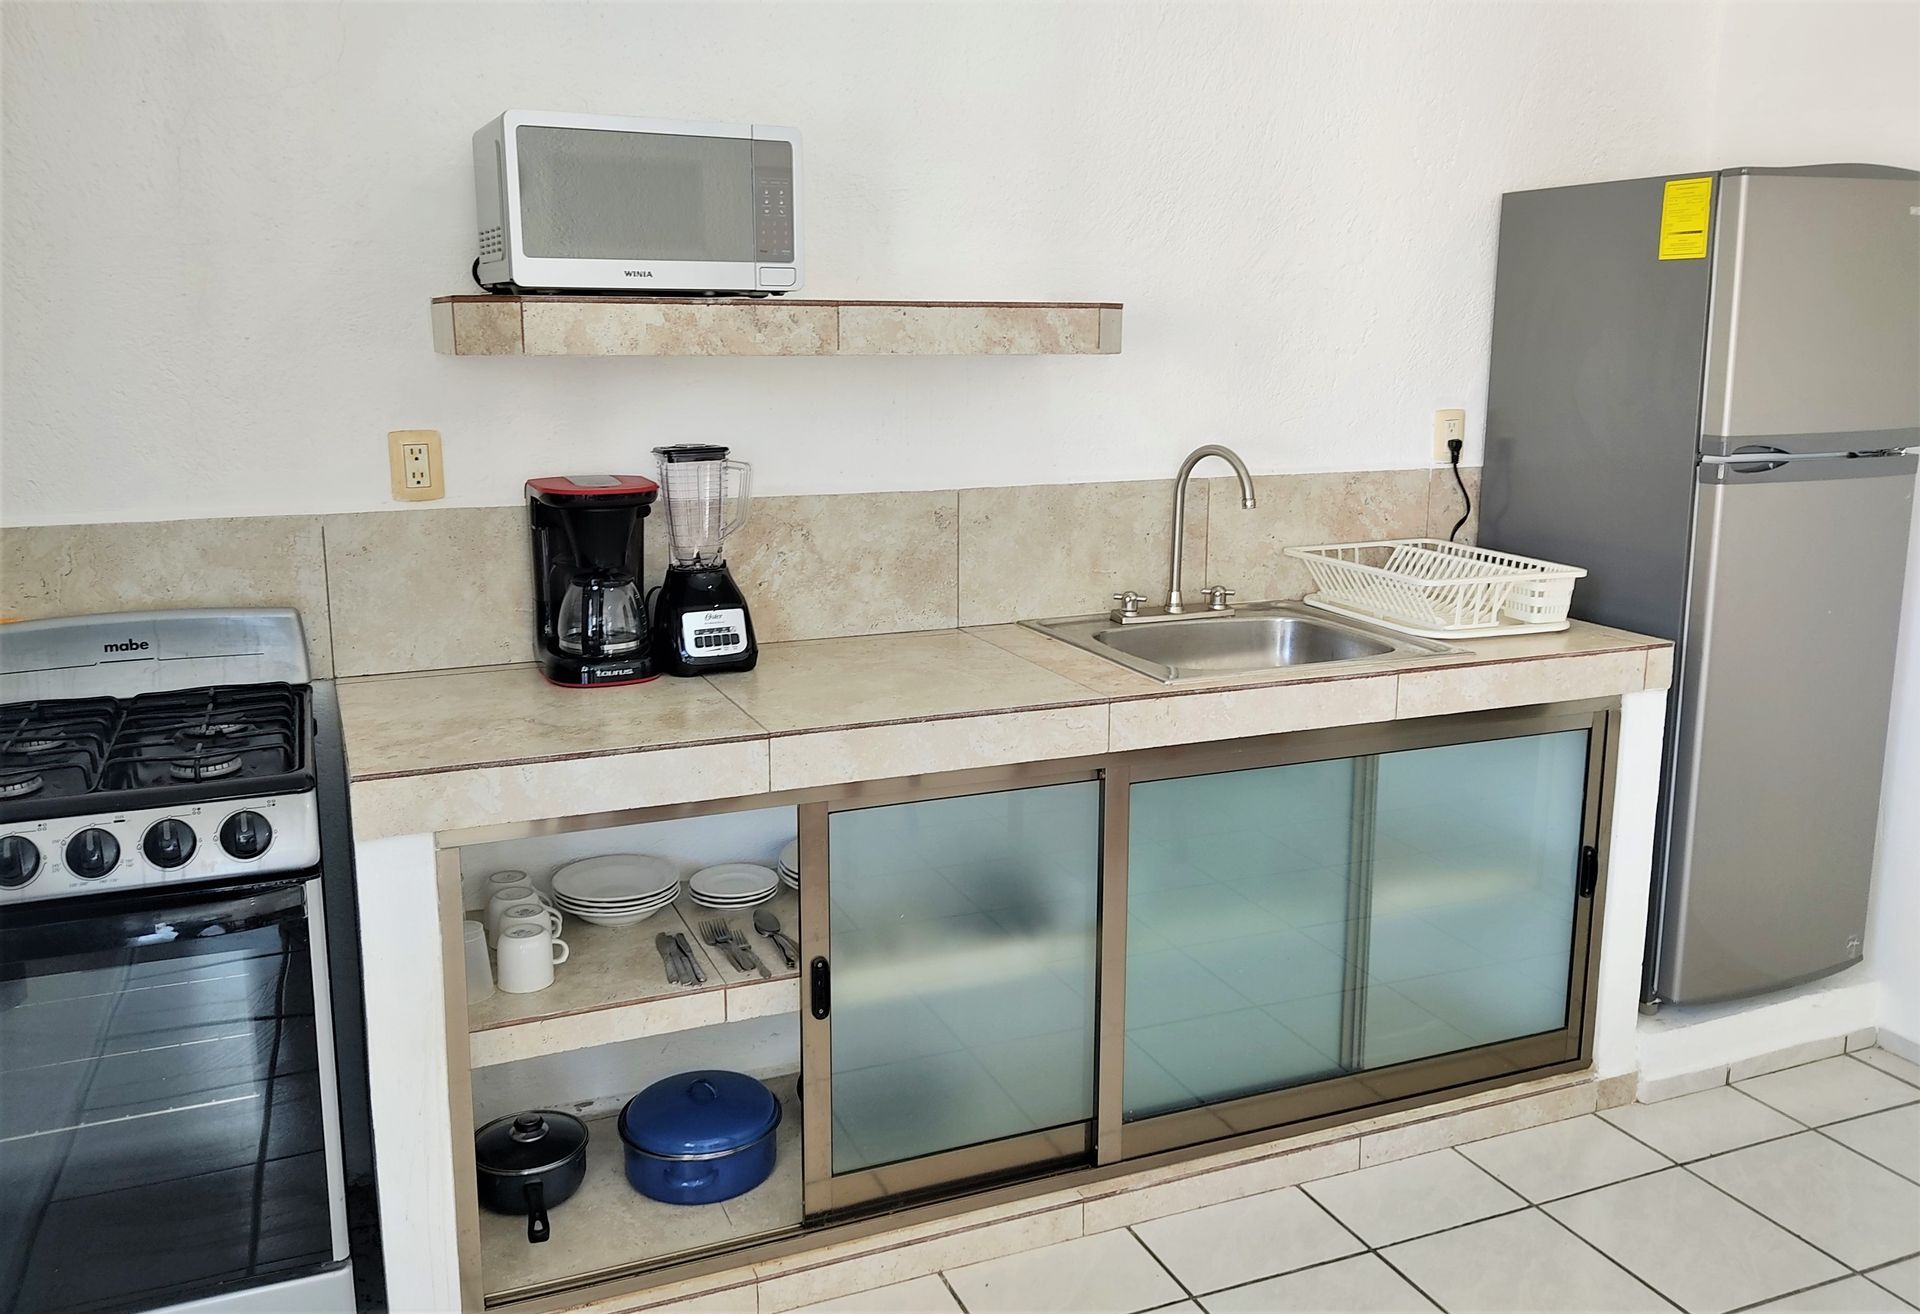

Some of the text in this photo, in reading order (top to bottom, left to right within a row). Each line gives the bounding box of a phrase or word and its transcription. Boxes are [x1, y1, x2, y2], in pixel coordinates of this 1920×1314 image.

[624, 270, 653, 278] WINIA
[705, 613, 723, 621] Oster
[104, 638, 149, 653] mabe
[595, 668, 634, 677] taurus
